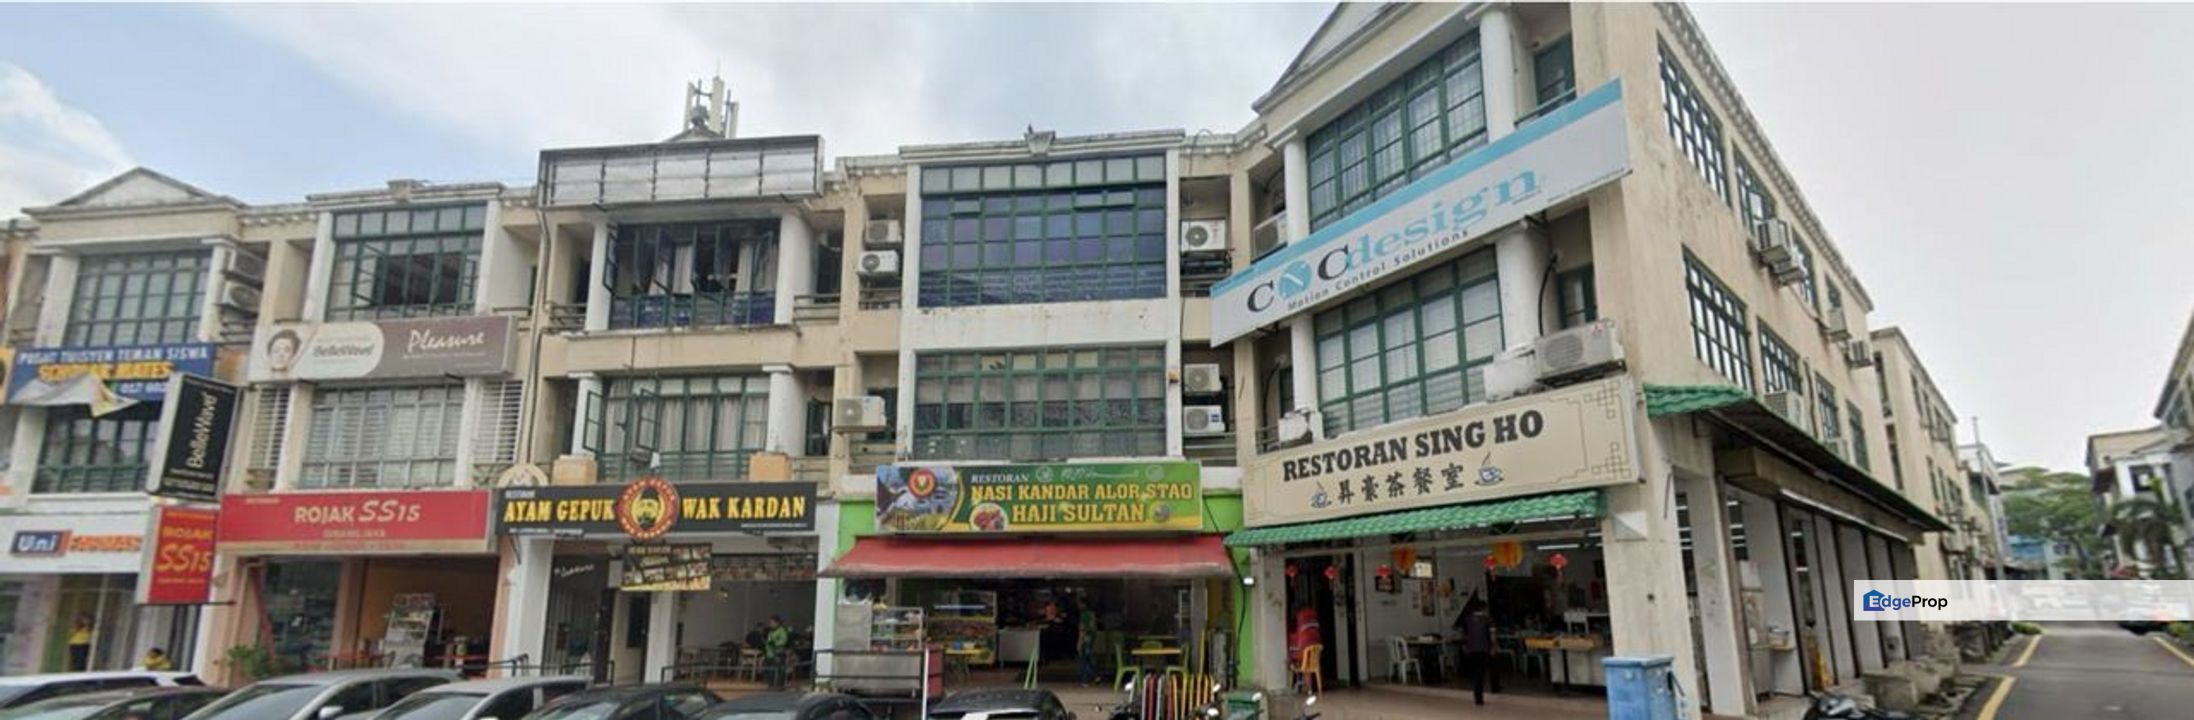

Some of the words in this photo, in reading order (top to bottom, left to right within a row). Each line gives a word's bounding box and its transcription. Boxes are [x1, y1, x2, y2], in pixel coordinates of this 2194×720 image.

[1287, 287, 1330, 311] Motion
[1335, 262, 1386, 291] Control
[1394, 229, 1470, 267] Solutions
[408, 329, 485, 353] Pleasure
[117, 348, 164, 361] TEMAN
[167, 346, 208, 360] SISWA
[1282, 437, 1408, 482] RESTORAN
[1415, 421, 1486, 458] SING
[1493, 410, 1544, 444] HO
[970, 473, 1030, 483] RESTORAN
[971, 485, 1012, 501] NASI
[1018, 484, 1090, 500] KANDAR
[1095, 484, 1140, 499] ALOR
[294, 505, 354, 524] ROJAK
[358, 499, 421, 522] SS15
[504, 501, 552, 522] AYAM
[556, 499, 616, 522] GEPUK
[682, 497, 721, 519] WAK
[727, 495, 806, 519] KARDAN
[1012, 503, 1056, 522] HAJI
[1061, 503, 1147, 522] SULTAN
[156, 543, 212, 572] SS15
